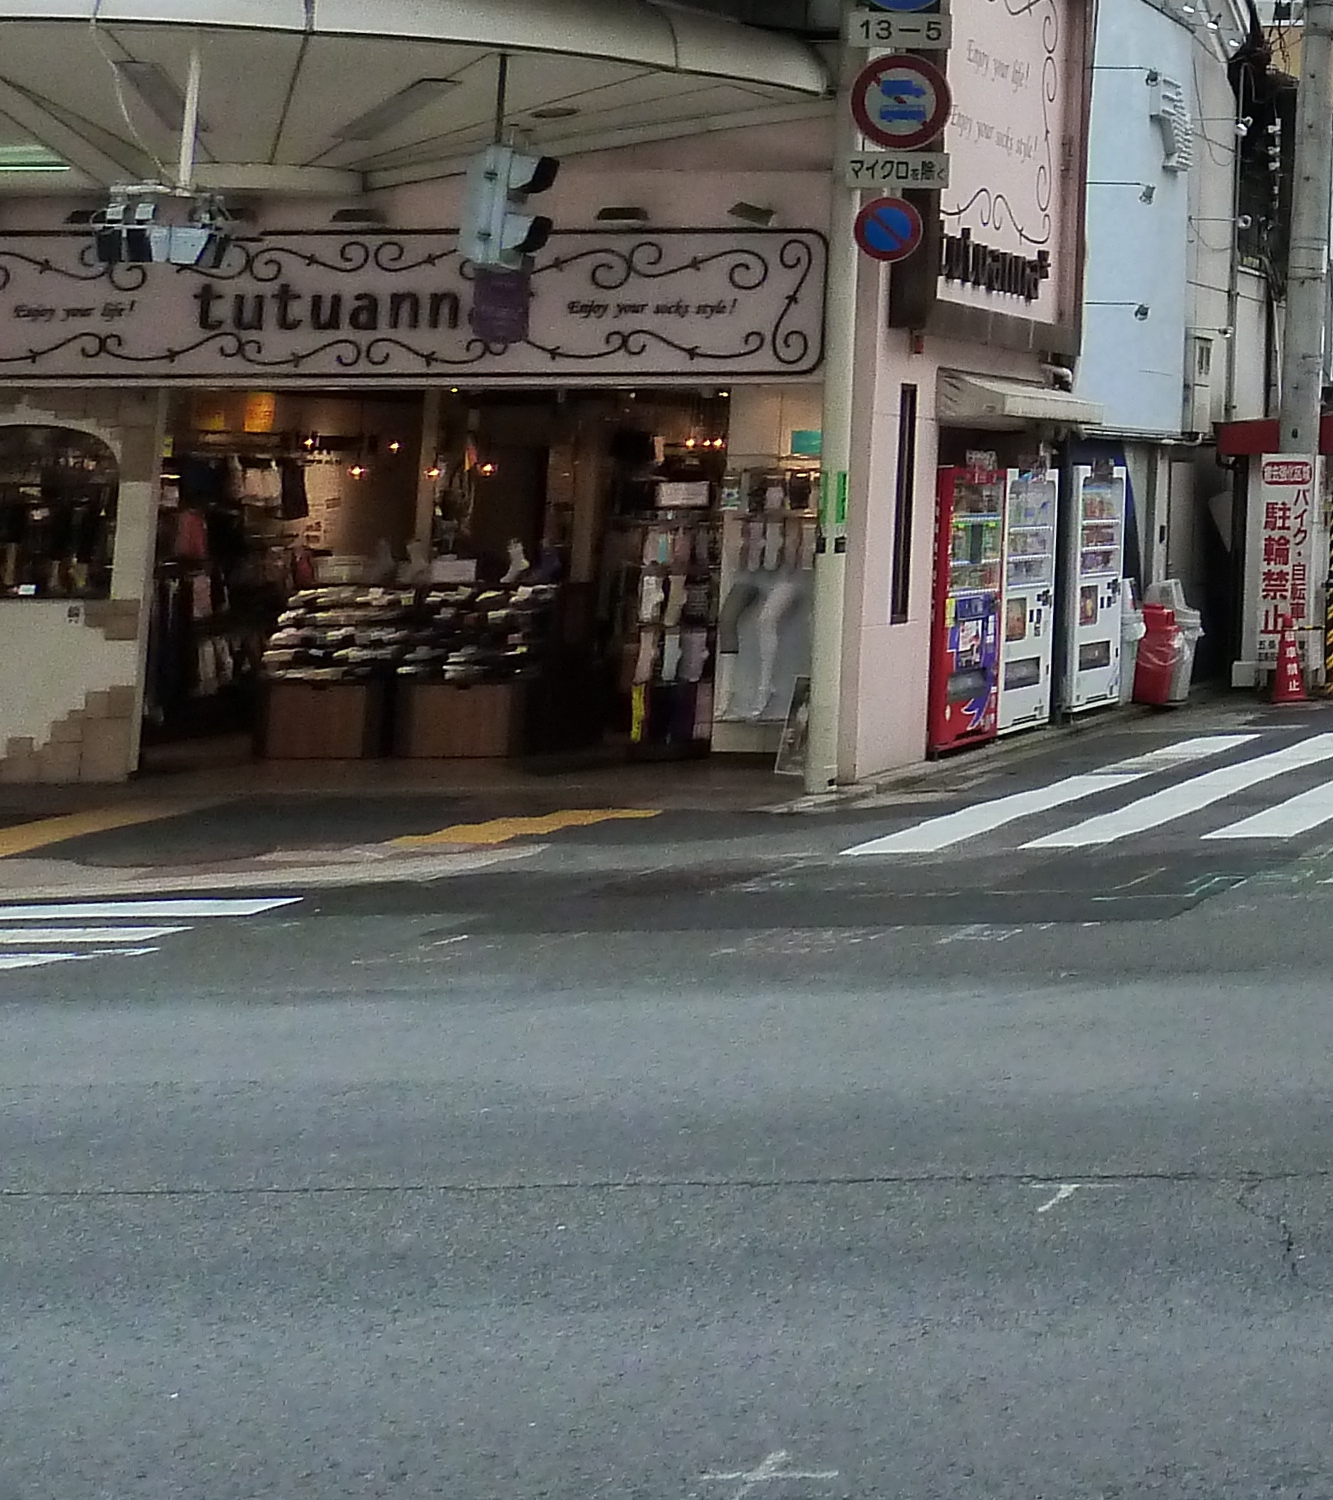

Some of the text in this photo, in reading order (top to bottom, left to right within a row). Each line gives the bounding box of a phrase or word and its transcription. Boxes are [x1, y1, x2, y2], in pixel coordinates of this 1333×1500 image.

[860, 19, 943, 41] 13-5
[991, 58, 1010, 82] your
[974, 120, 995, 143] your
[849, 160, 947, 181] マイクロを除く
[62, 305, 96, 322] your
[193, 281, 466, 331] tutuann
[566, 299, 609, 319] Enjoy
[612, 302, 649, 319] your
[652, 298, 691, 320] socks
[1289, 487, 1310, 620] バイク・自転車
[1260, 501, 1291, 634] 駐輪禁止
